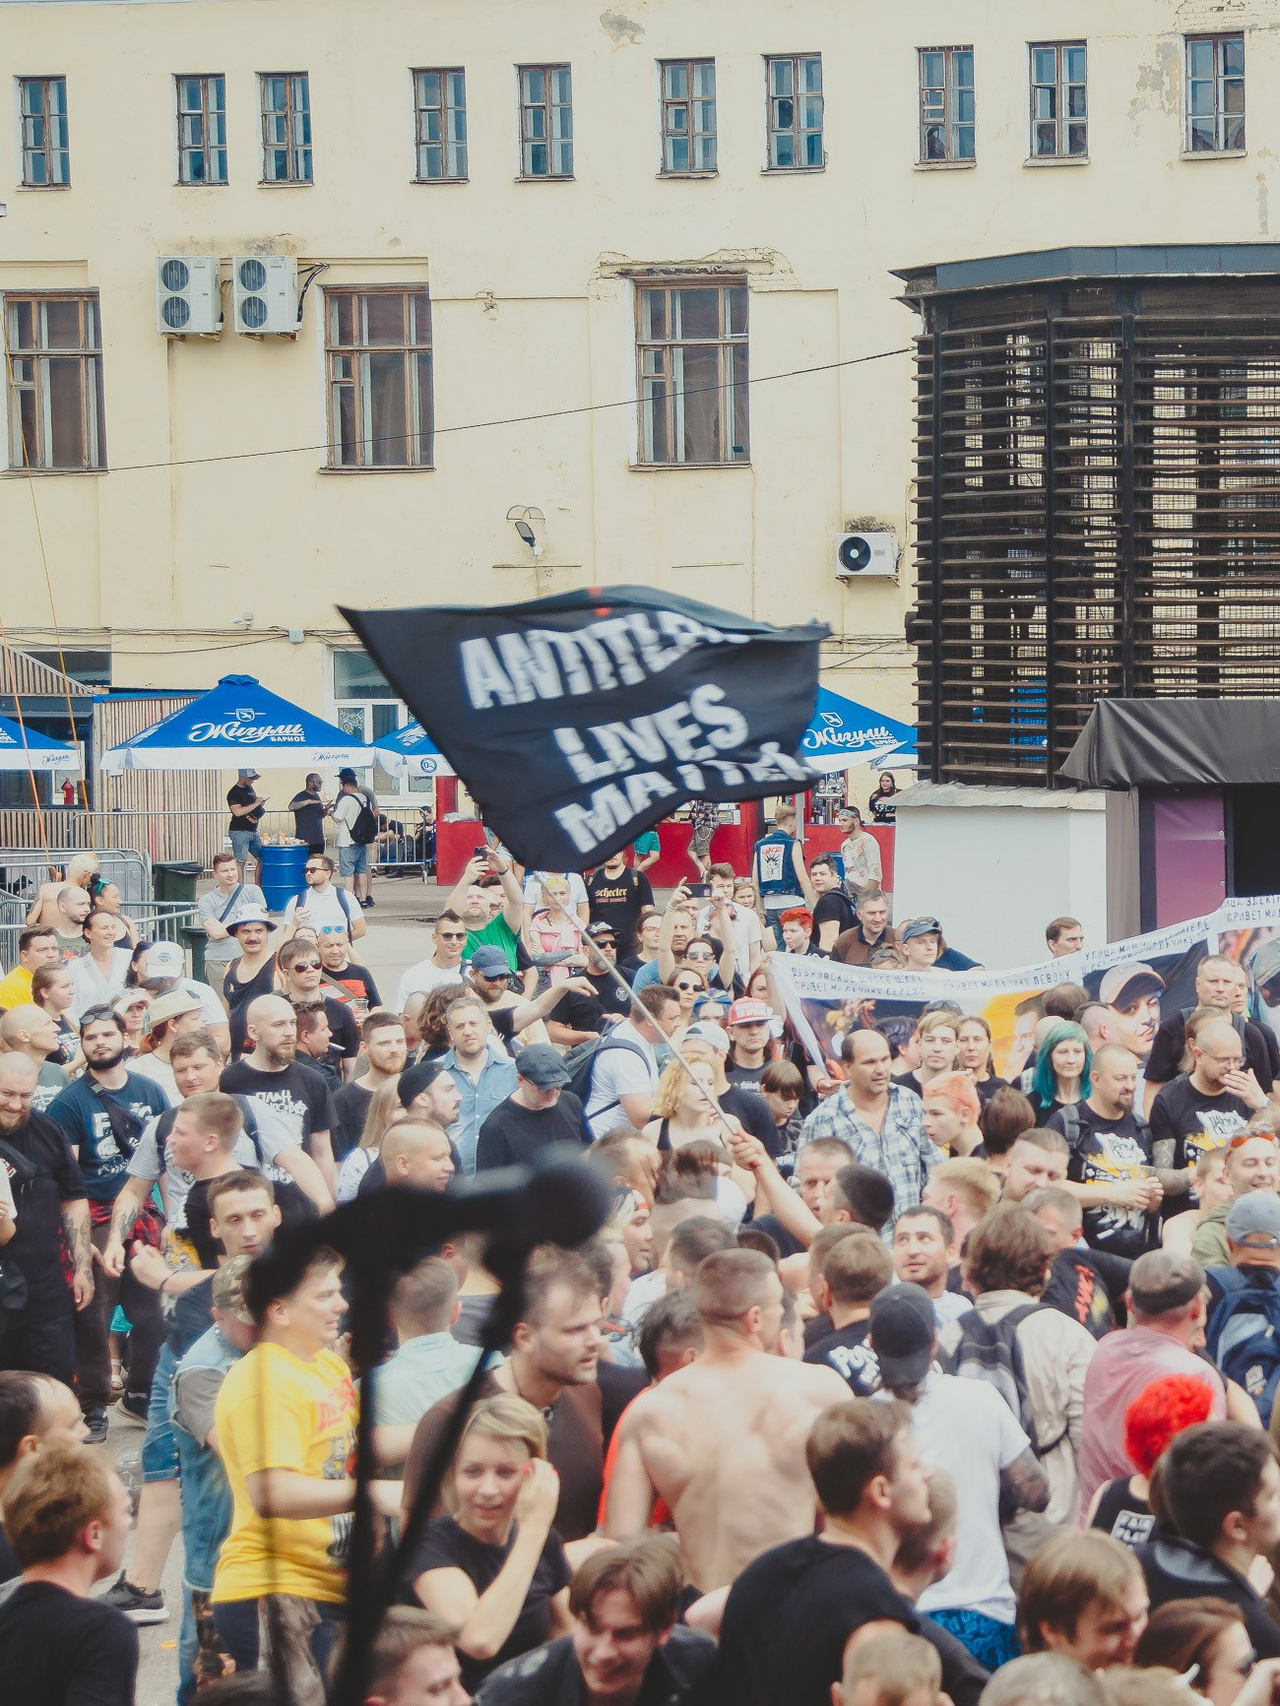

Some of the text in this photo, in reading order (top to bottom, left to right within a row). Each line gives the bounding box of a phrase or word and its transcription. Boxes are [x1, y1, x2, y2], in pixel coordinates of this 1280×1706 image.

[188, 720, 303, 743] Жигули
[553, 683, 750, 784] LIVES
[801, 726, 894, 749] Жигули
[1226, 909, 1262, 923] ПРИВЕТ
